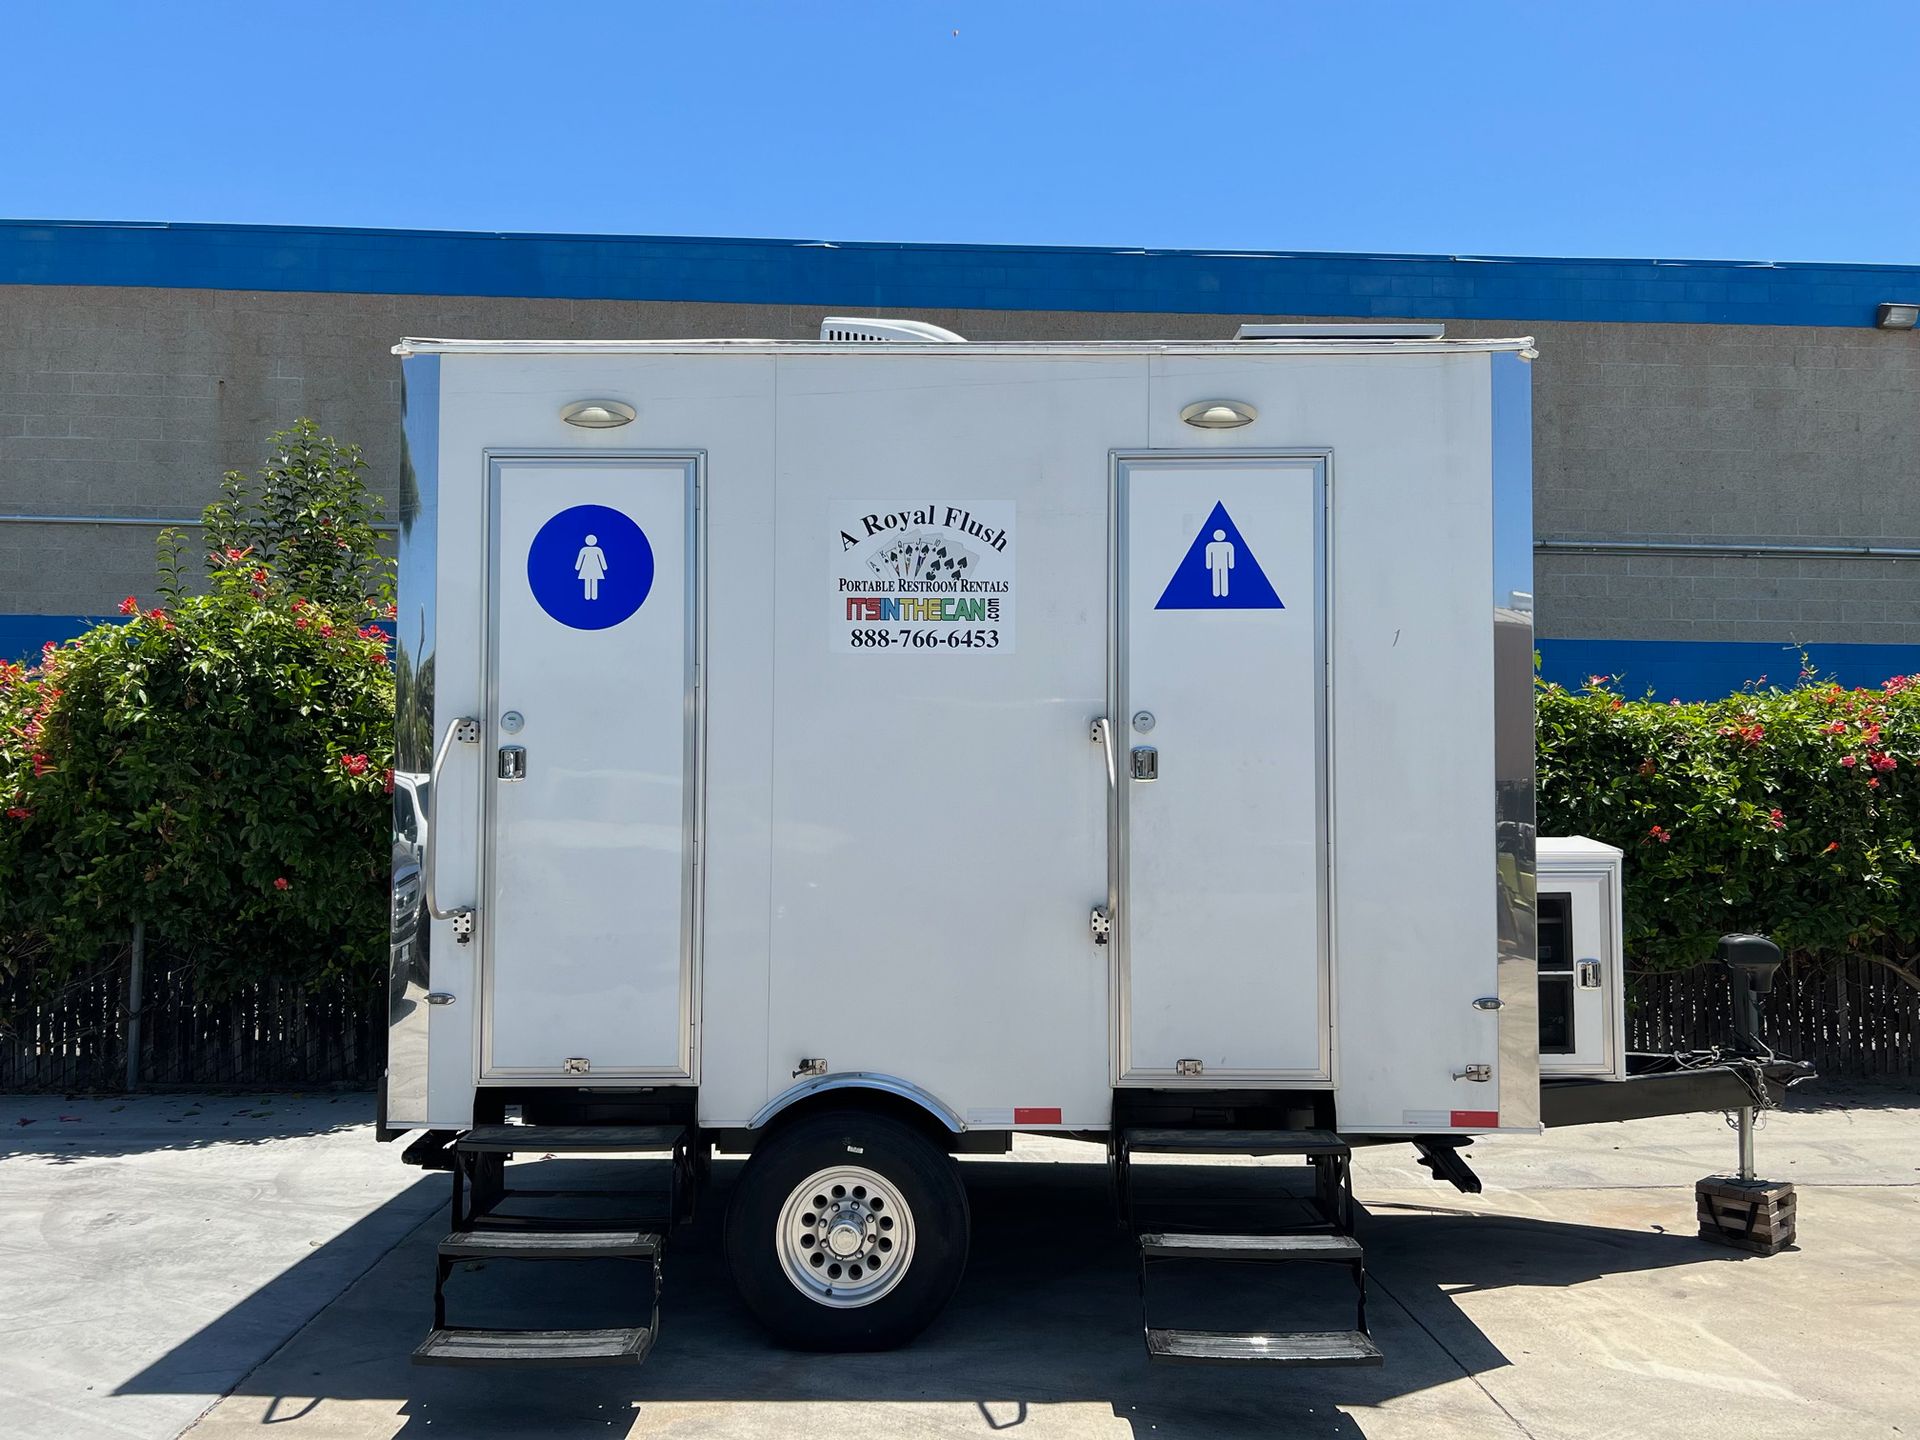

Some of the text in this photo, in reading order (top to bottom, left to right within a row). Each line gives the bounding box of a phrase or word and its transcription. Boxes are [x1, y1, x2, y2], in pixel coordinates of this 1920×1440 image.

[839, 505, 1008, 553] A Royal Flush
[838, 578, 1009, 593] PORTABLE RESTROOM RENTALS
[850, 629, 999, 648] 888-766-6453
